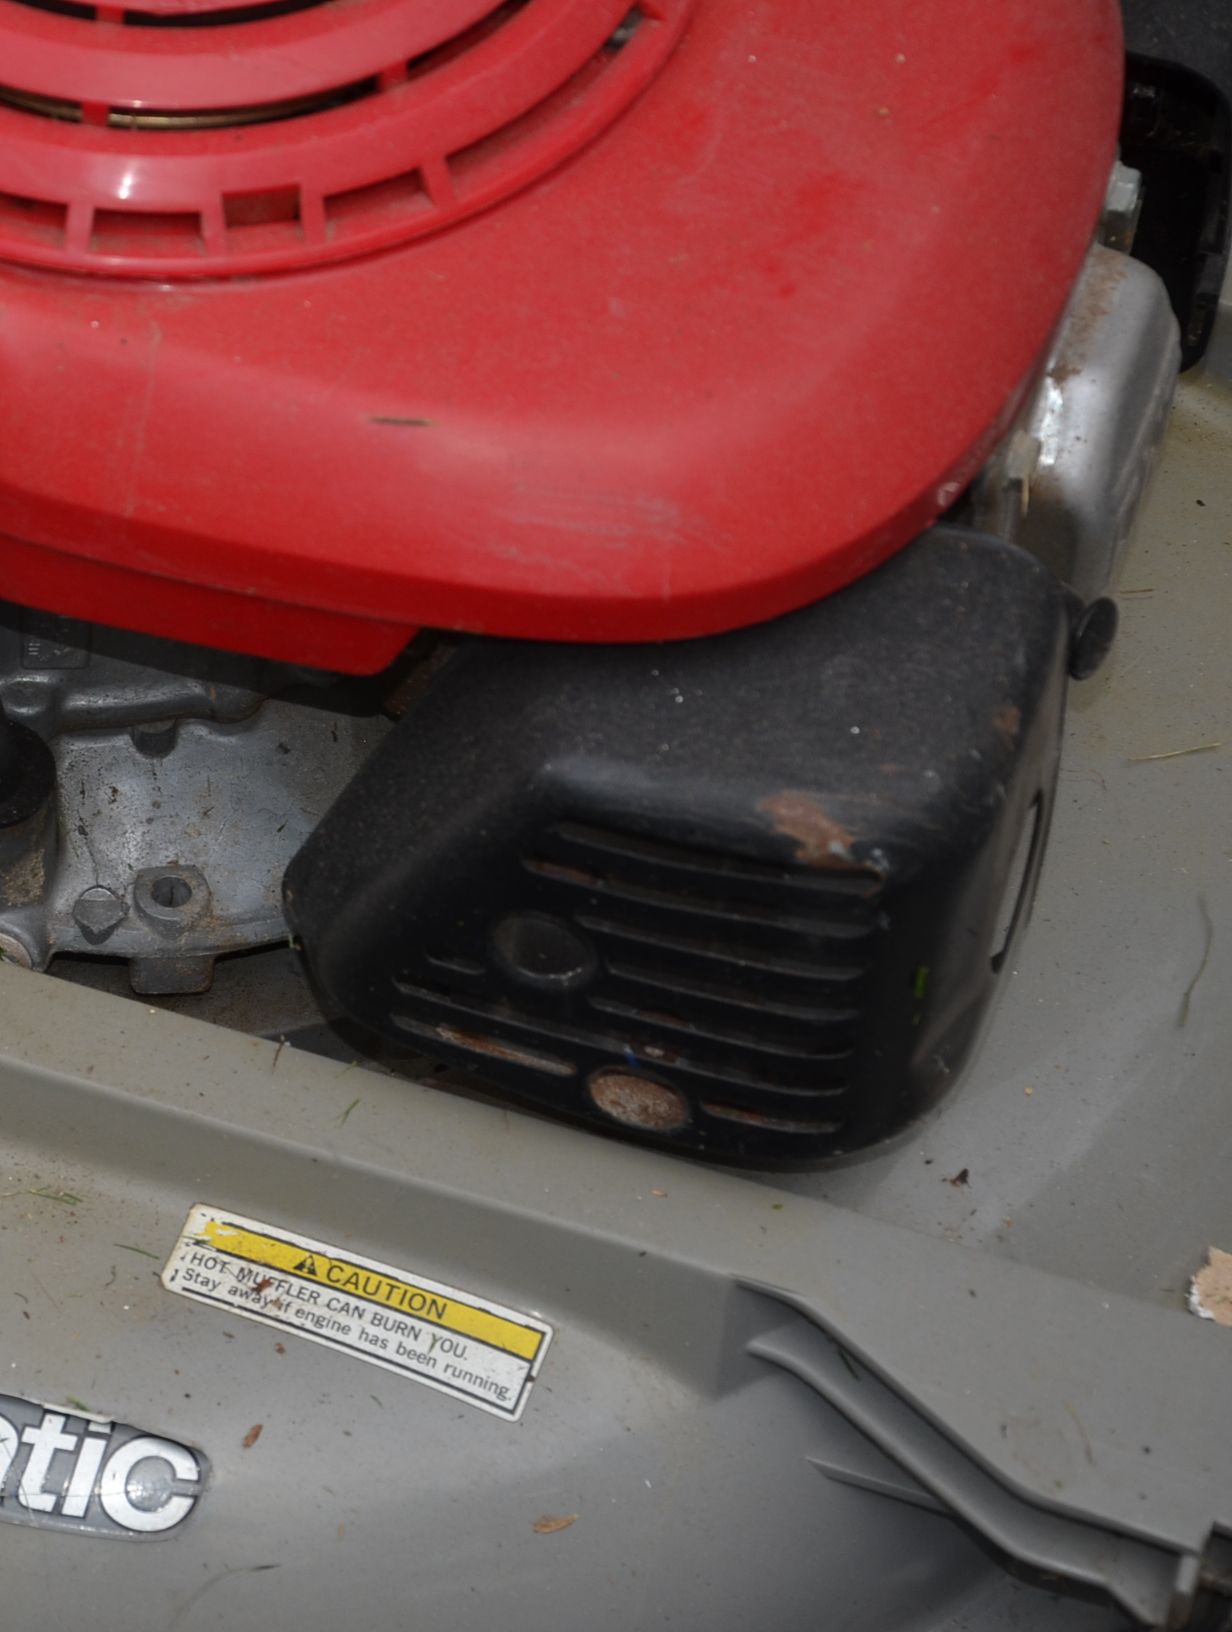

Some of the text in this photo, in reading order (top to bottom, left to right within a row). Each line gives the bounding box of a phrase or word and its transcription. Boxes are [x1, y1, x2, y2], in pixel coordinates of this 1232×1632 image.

[183, 1268, 221, 1292] Stay
[228, 1285, 273, 1310] away
[295, 1307, 351, 1335] engine
[358, 1326, 389, 1349] has
[396, 1341, 437, 1369] been
[191, 1252, 230, 1273] HOT
[327, 1297, 365, 1320] CAN
[370, 1312, 422, 1341] BURN
[431, 1332, 468, 1361] YOU.
[326, 1264, 447, 1320] CAUTION
